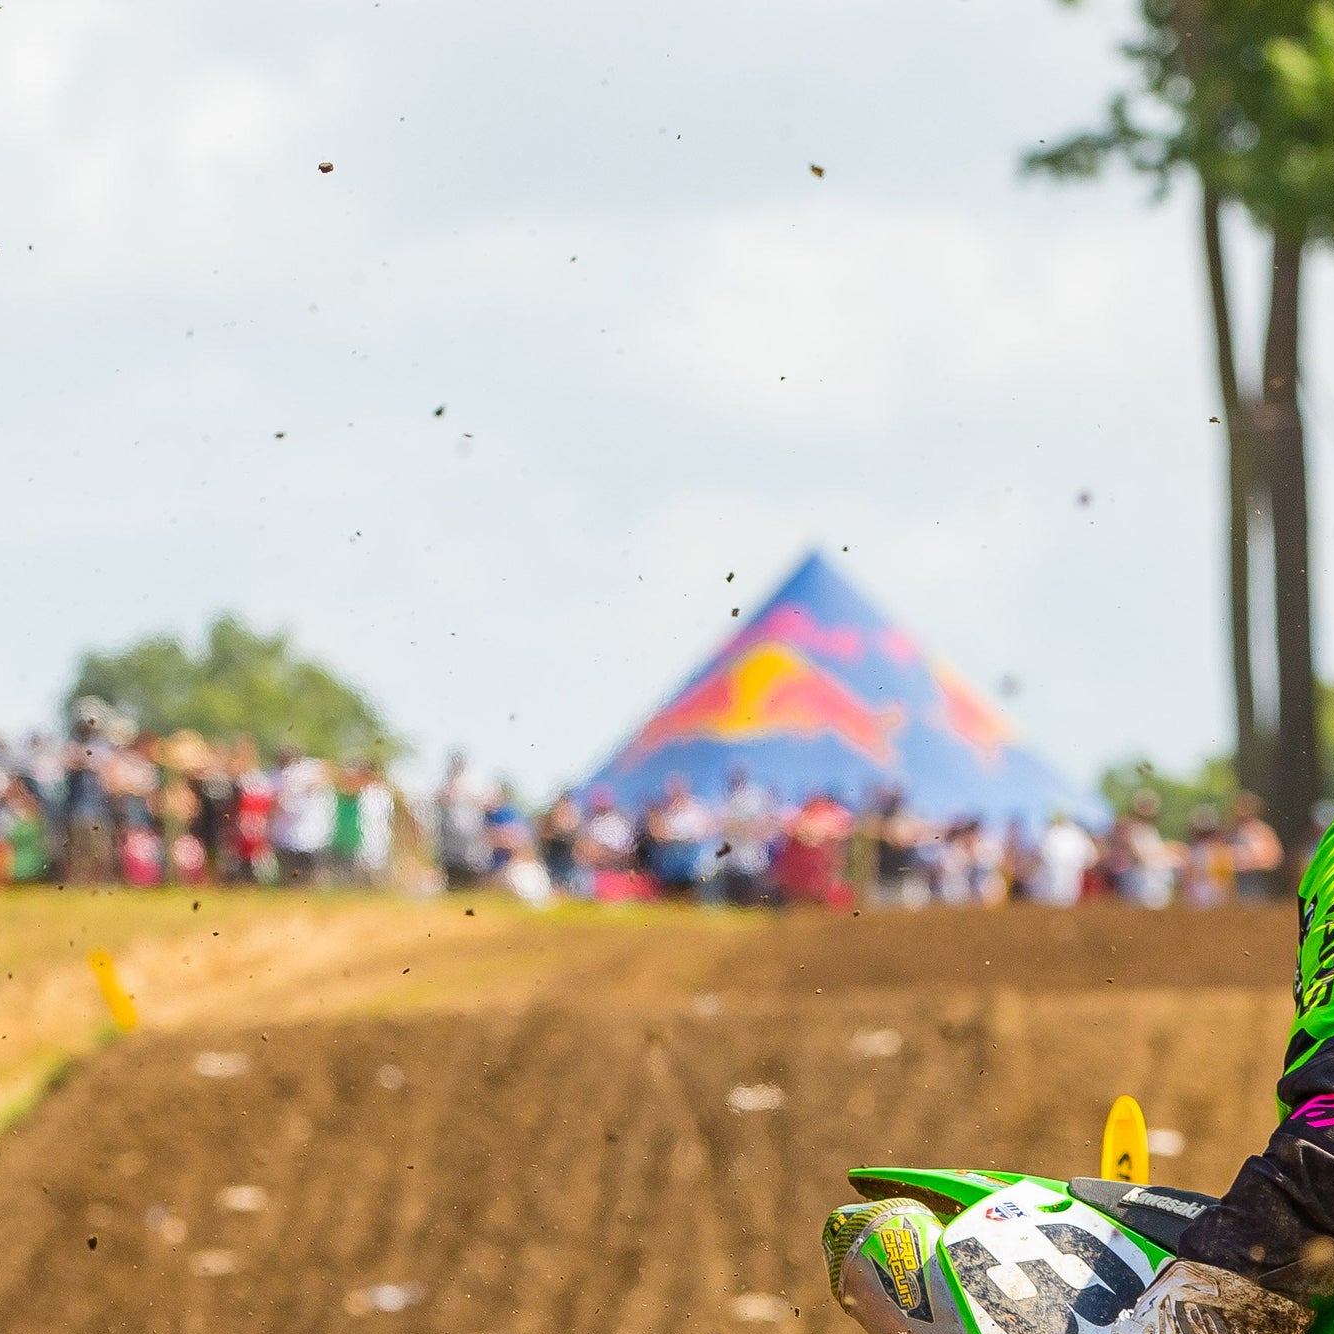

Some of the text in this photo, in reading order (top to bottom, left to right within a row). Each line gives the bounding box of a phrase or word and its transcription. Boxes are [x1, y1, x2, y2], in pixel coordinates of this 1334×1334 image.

[1121, 1186, 1208, 1220] Kawasaki
[881, 1229, 915, 1308] CIRCUIT
[895, 1228, 920, 1271] PRO
